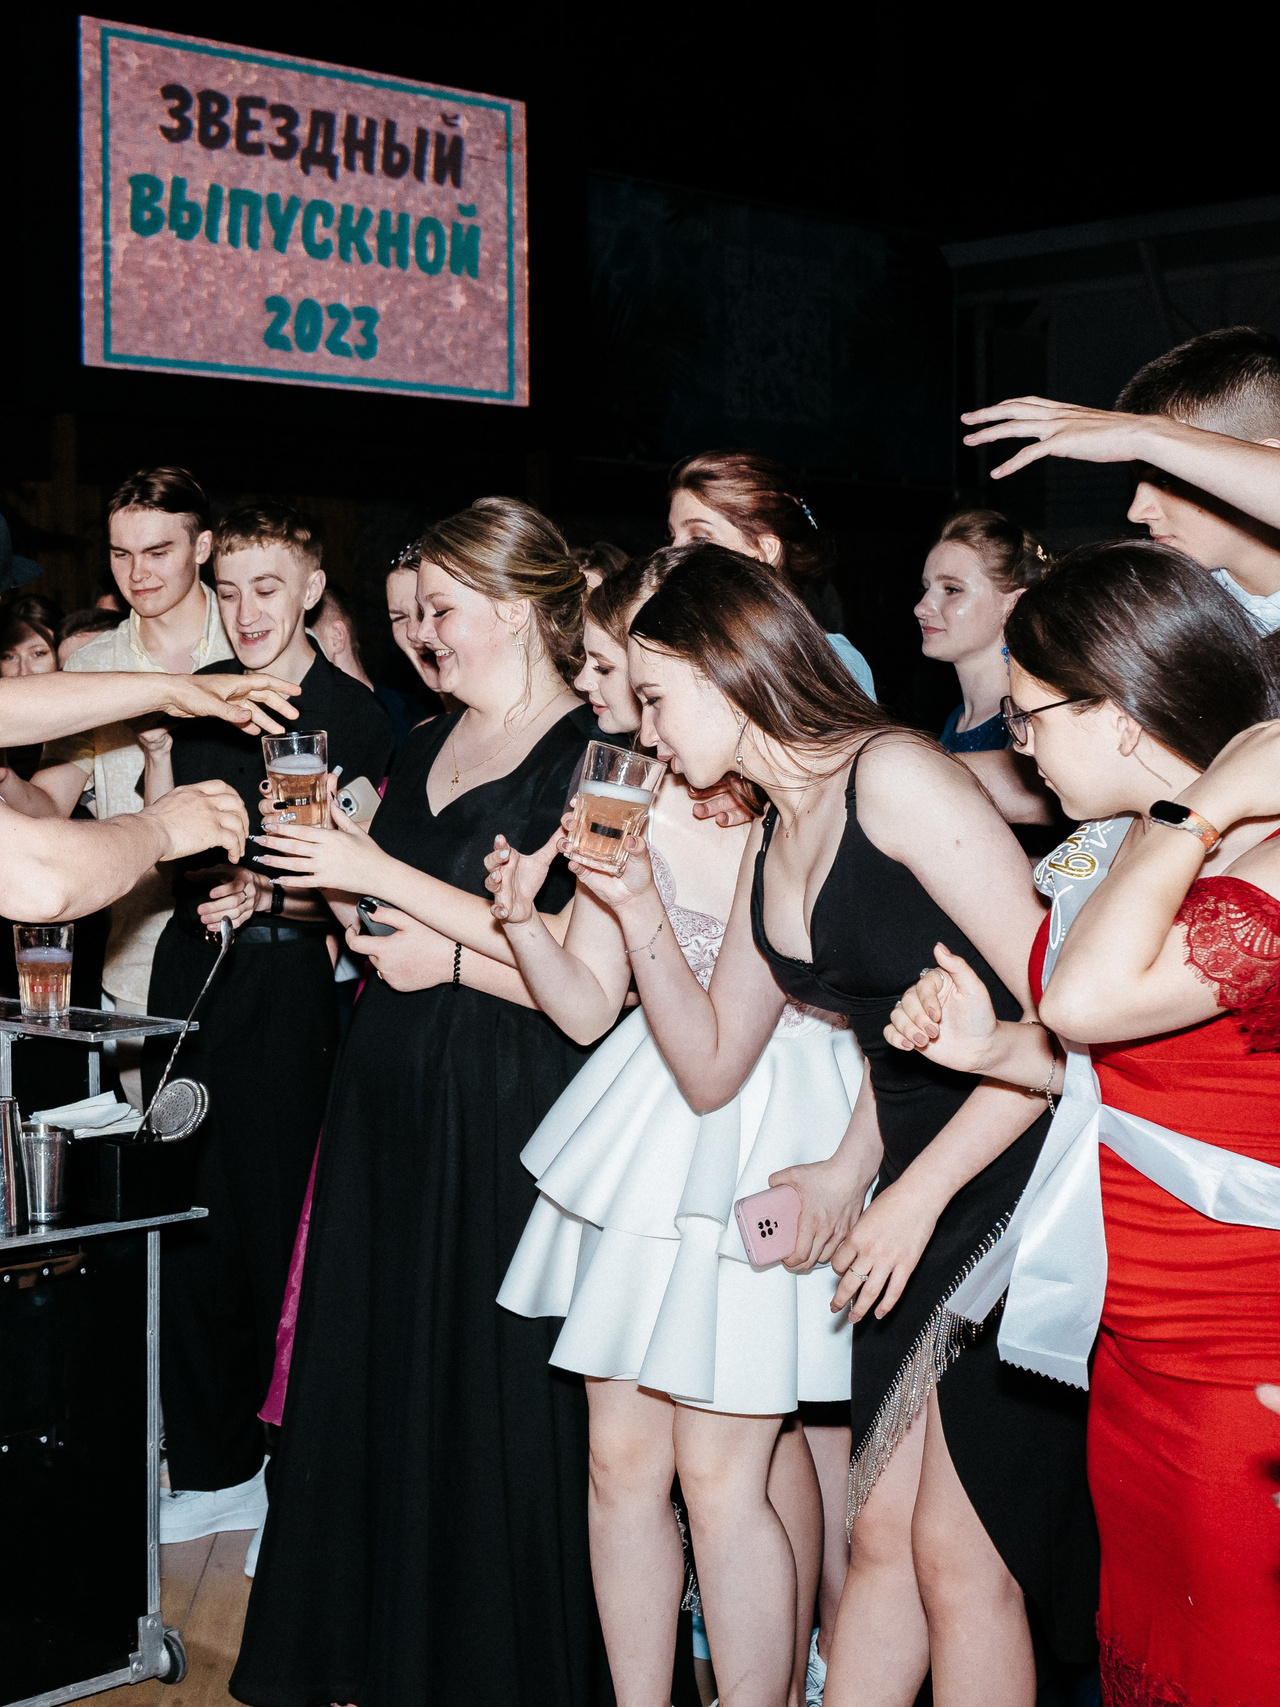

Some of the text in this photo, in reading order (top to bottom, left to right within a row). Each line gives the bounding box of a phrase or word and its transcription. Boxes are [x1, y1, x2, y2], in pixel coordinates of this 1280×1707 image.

[158, 83, 464, 189] ЗВЕЗДНЫЙ
[128, 173, 481, 279] ВЫПУСКНОЙ
[263, 295, 380, 361] 2023
